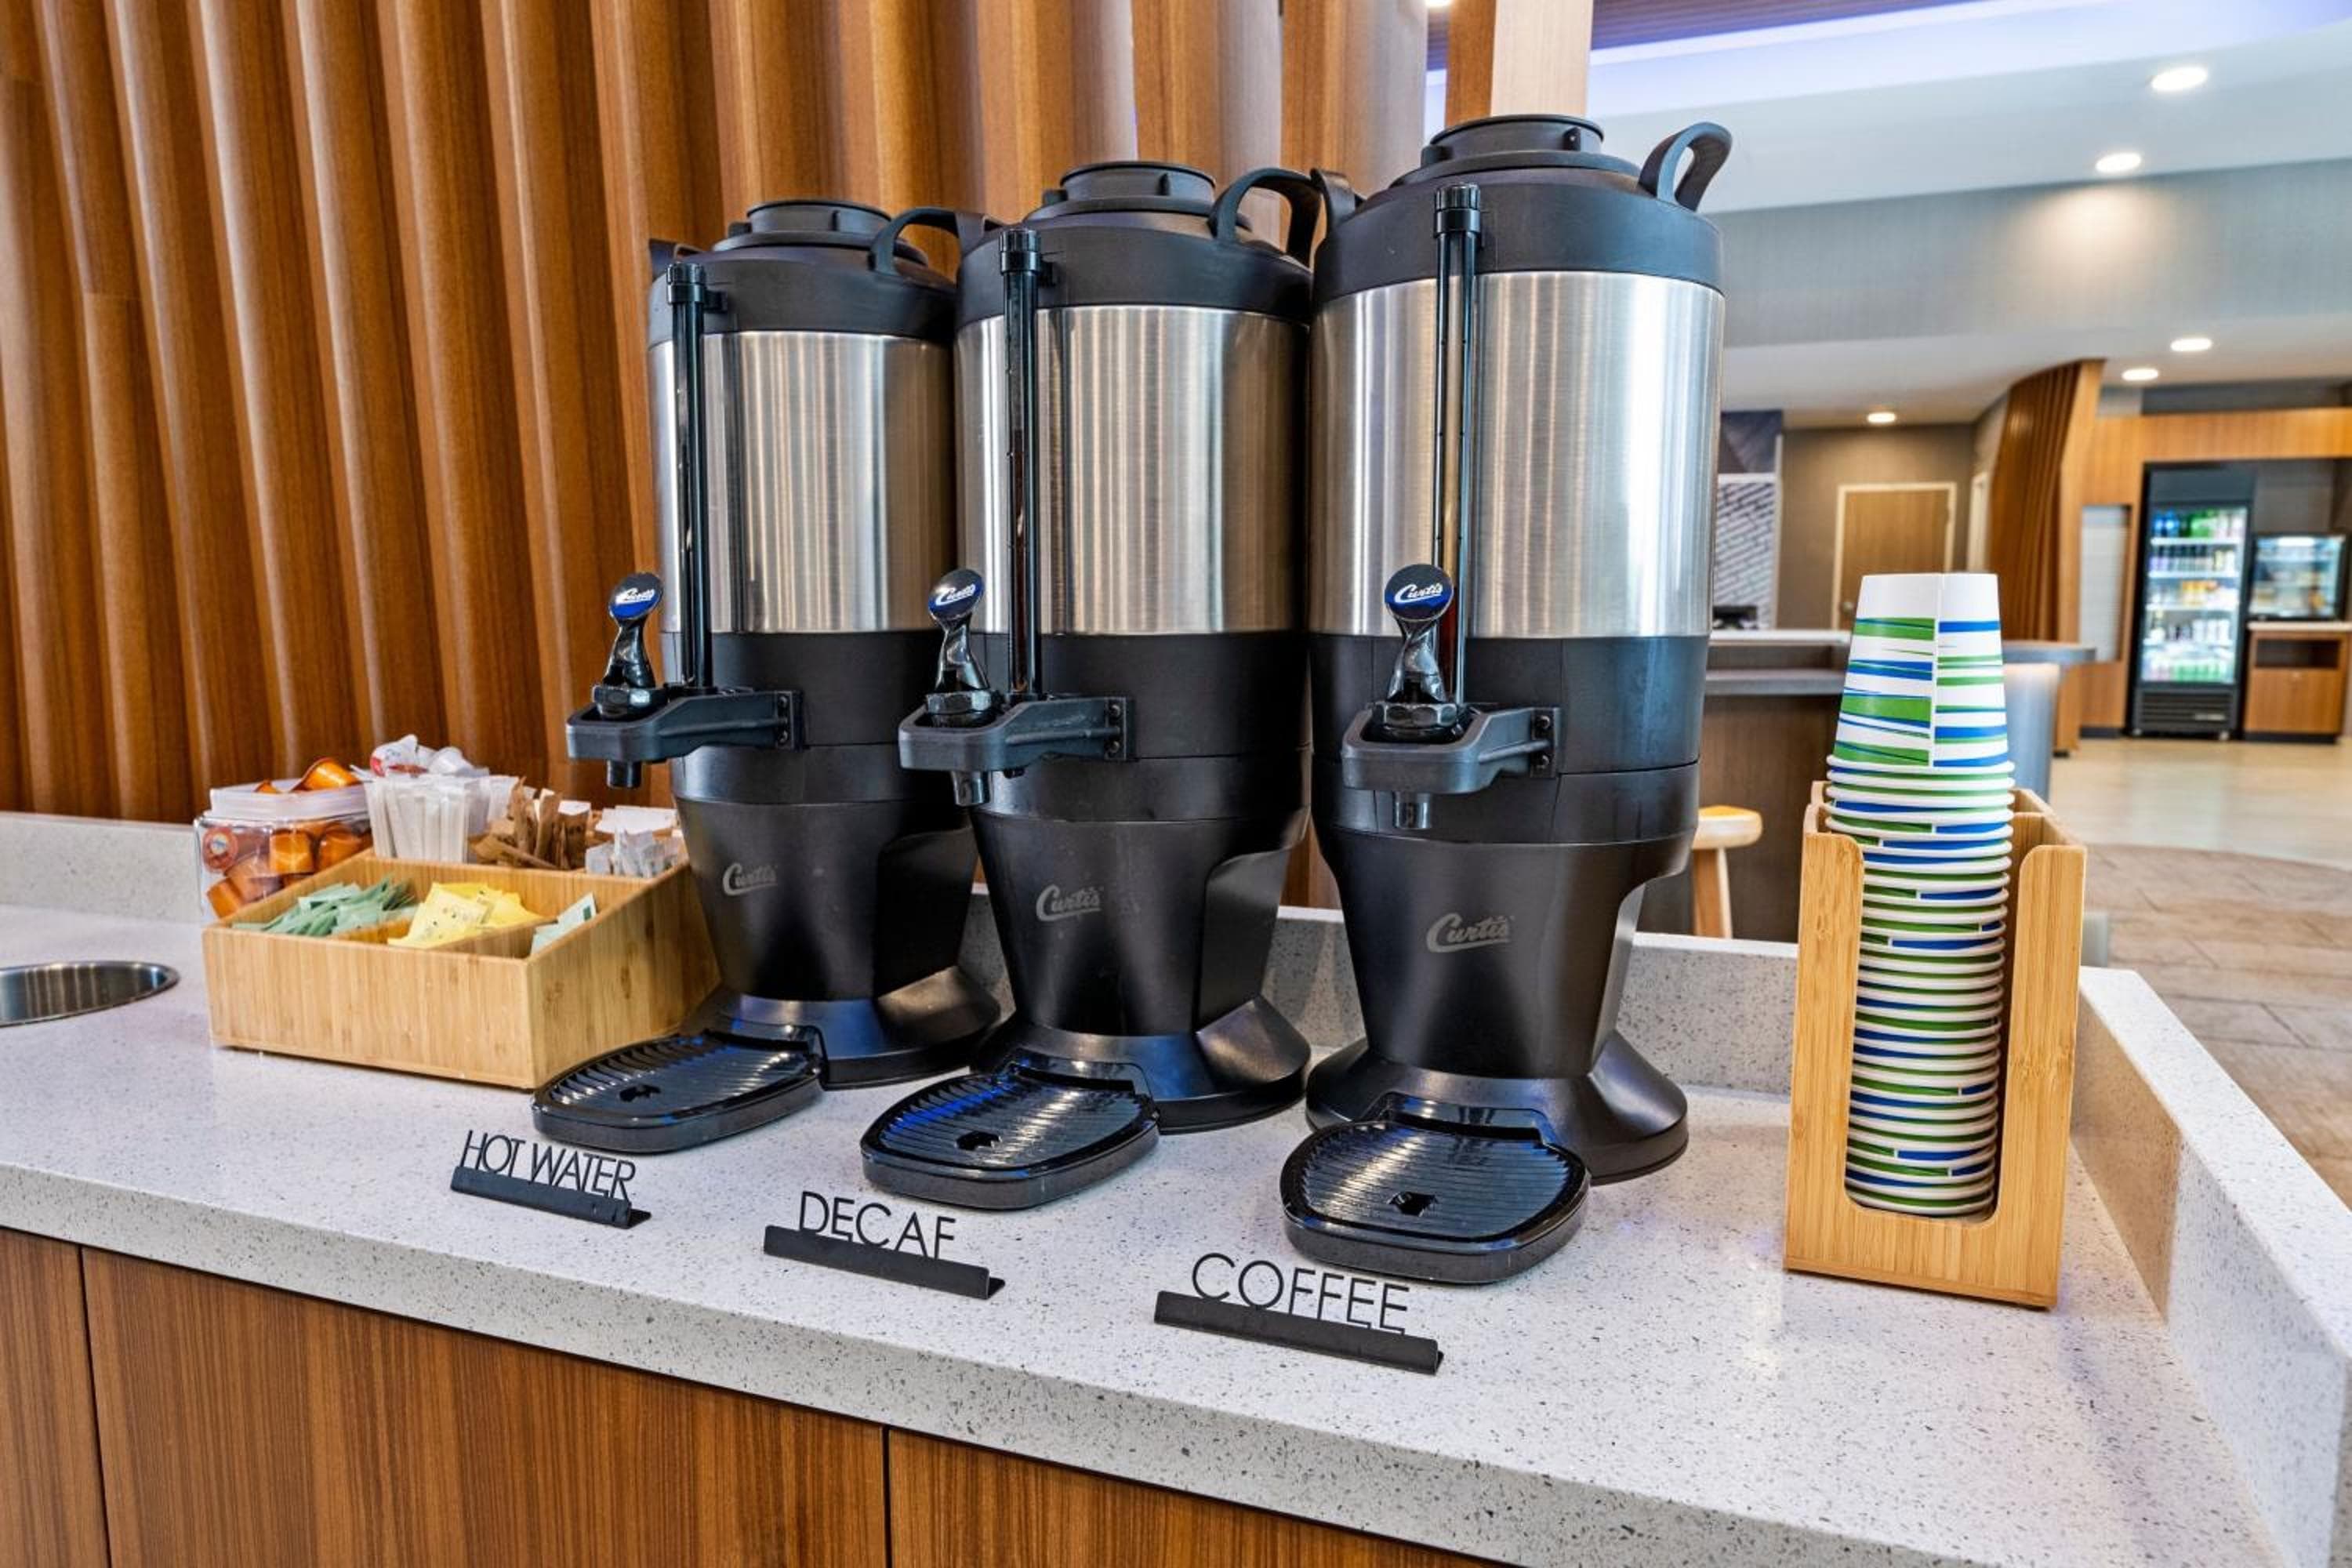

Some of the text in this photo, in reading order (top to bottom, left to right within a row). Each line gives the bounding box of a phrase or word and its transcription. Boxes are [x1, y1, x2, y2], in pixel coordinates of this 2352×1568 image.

[1394, 583, 1443, 604] Curtis
[459, 1129, 637, 1200] HOT WATER
[798, 1190, 956, 1260] DECAF
[1192, 1252, 1410, 1336] COFFEE
